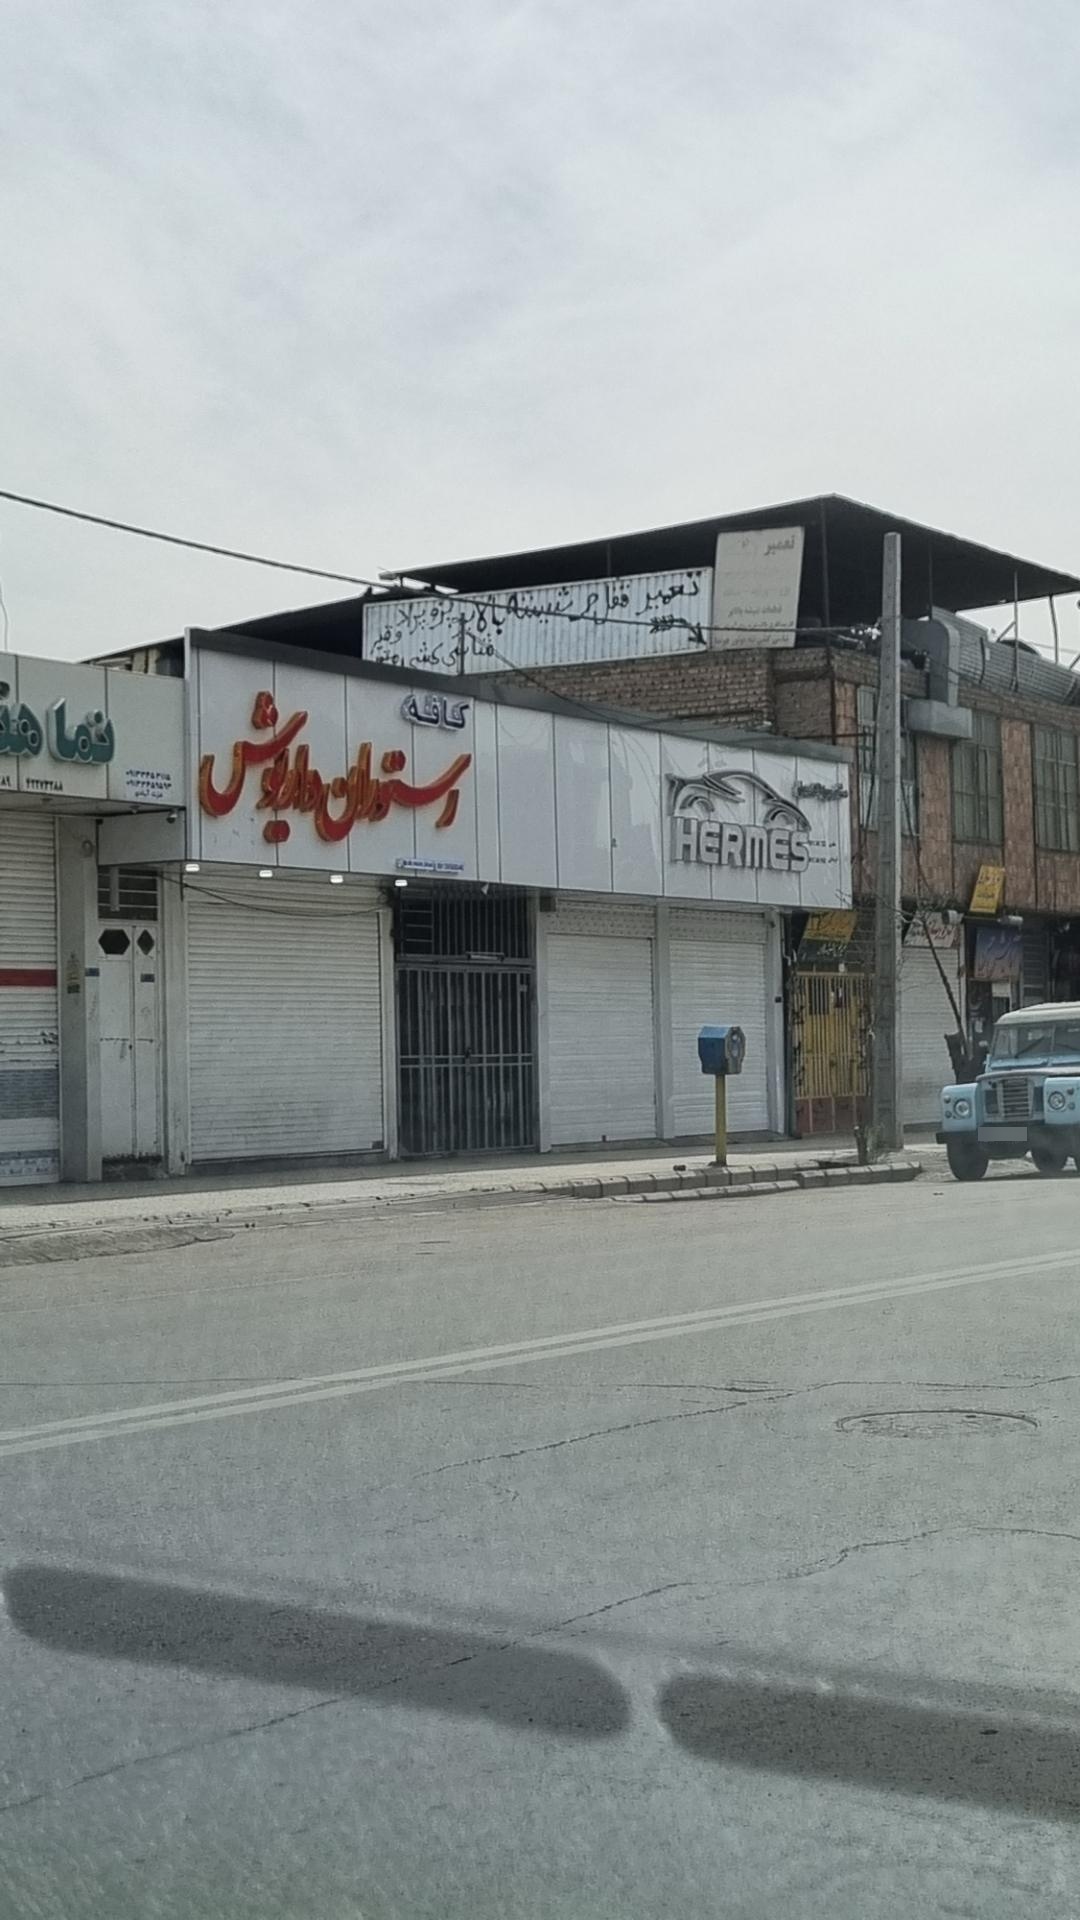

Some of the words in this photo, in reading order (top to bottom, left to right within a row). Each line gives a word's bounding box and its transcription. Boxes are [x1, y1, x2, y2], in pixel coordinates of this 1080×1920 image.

[635, 571, 702, 616] تعمیر
[401, 694, 470, 730] کافه
[315, 742, 472, 842] رستوران
[671, 815, 810, 873] HERMES
